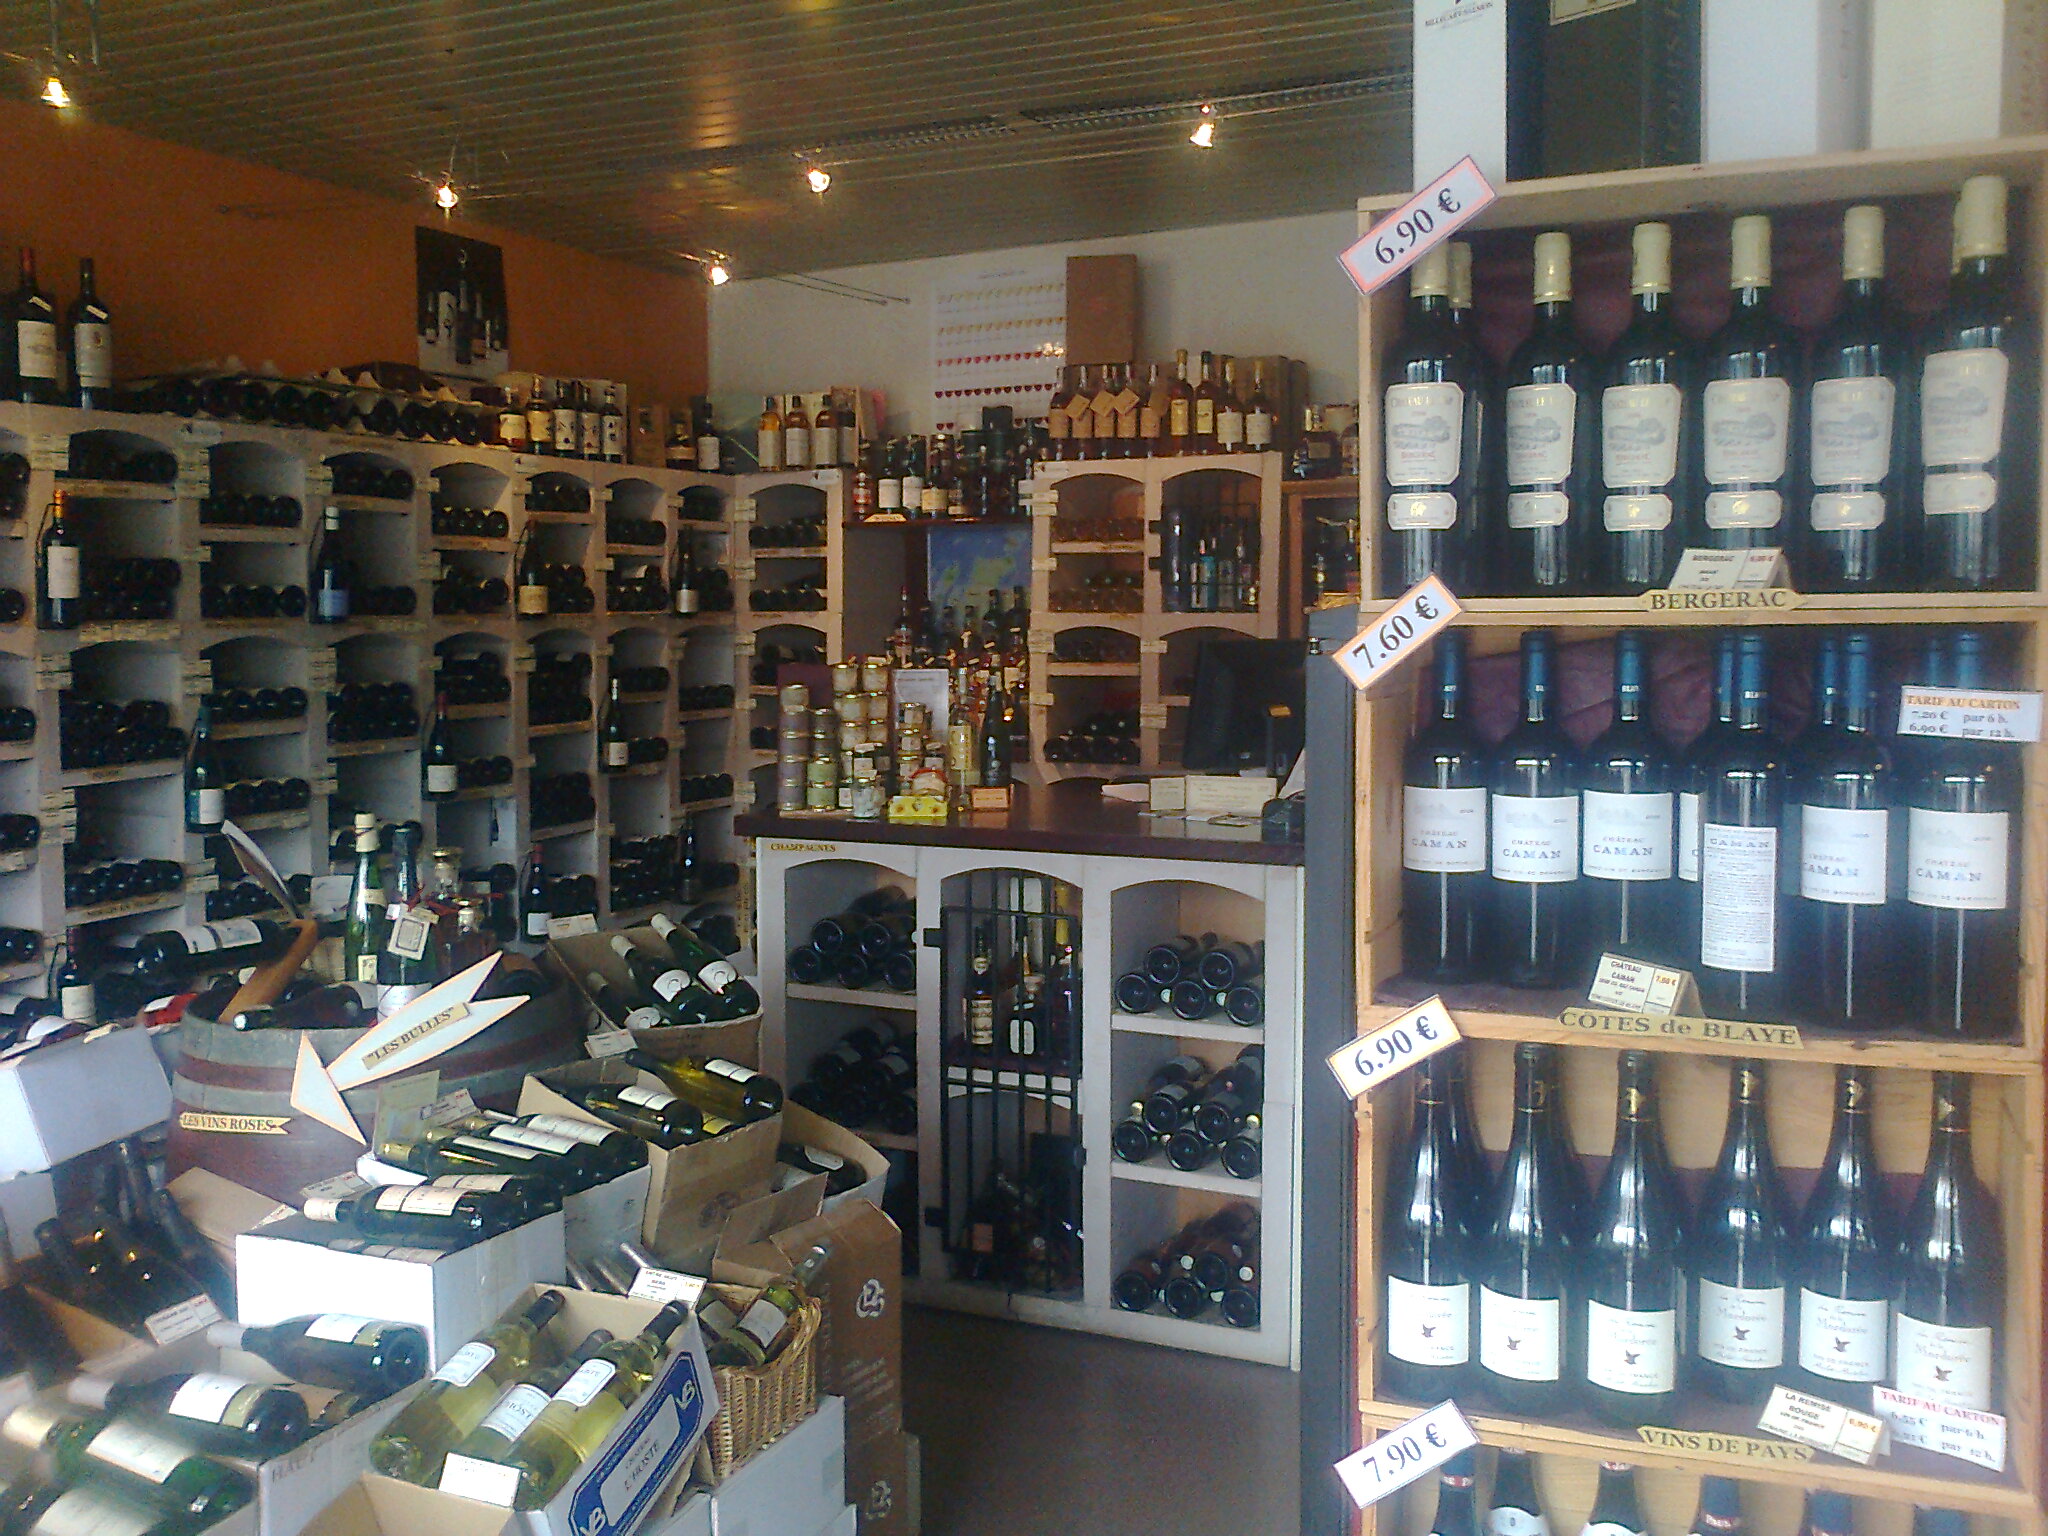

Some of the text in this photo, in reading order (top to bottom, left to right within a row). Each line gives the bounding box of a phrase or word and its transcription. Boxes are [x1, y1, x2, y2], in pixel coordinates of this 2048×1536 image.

[1375, 188, 1461, 264] 6.90 €
[1651, 590, 1786, 610] BERGERAC
[1352, 594, 1439, 669] 7.60 €
[1907, 695, 2020, 710] TARIF AU CARTON
[1940, 710, 1949, 720] €
[1963, 714, 1985, 724] par
[1909, 723, 1936, 733] 6.90
[1939, 724, 1949, 734] €
[1962, 728, 1984, 738] par
[1411, 838, 1467, 849] CAMAN
[1593, 844, 1653, 857] CAMAN
[1710, 838, 1769, 848] CAMAN
[1503, 848, 1561, 860] CAMAN
[1916, 867, 1982, 882] CAMAN
[1660, 1019, 1692, 1035] de
[1703, 1021, 1797, 1045] BLAYE
[1355, 1015, 1438, 1076] 6.90 €
[184, 1114, 199, 1127] LES
[201, 1116, 228, 1129] VINS
[1785, 1393, 1796, 1401] LA
[1789, 1405, 1820, 1420] ROUGE
[1881, 1390, 1999, 1426] TARIF AU CARTON
[1941, 1424, 1961, 1435] par
[1362, 1422, 1447, 1483] 7.90 €
[1643, 1429, 1808, 1462] VINS DE PAYS
[1941, 1442, 1961, 1452] par
